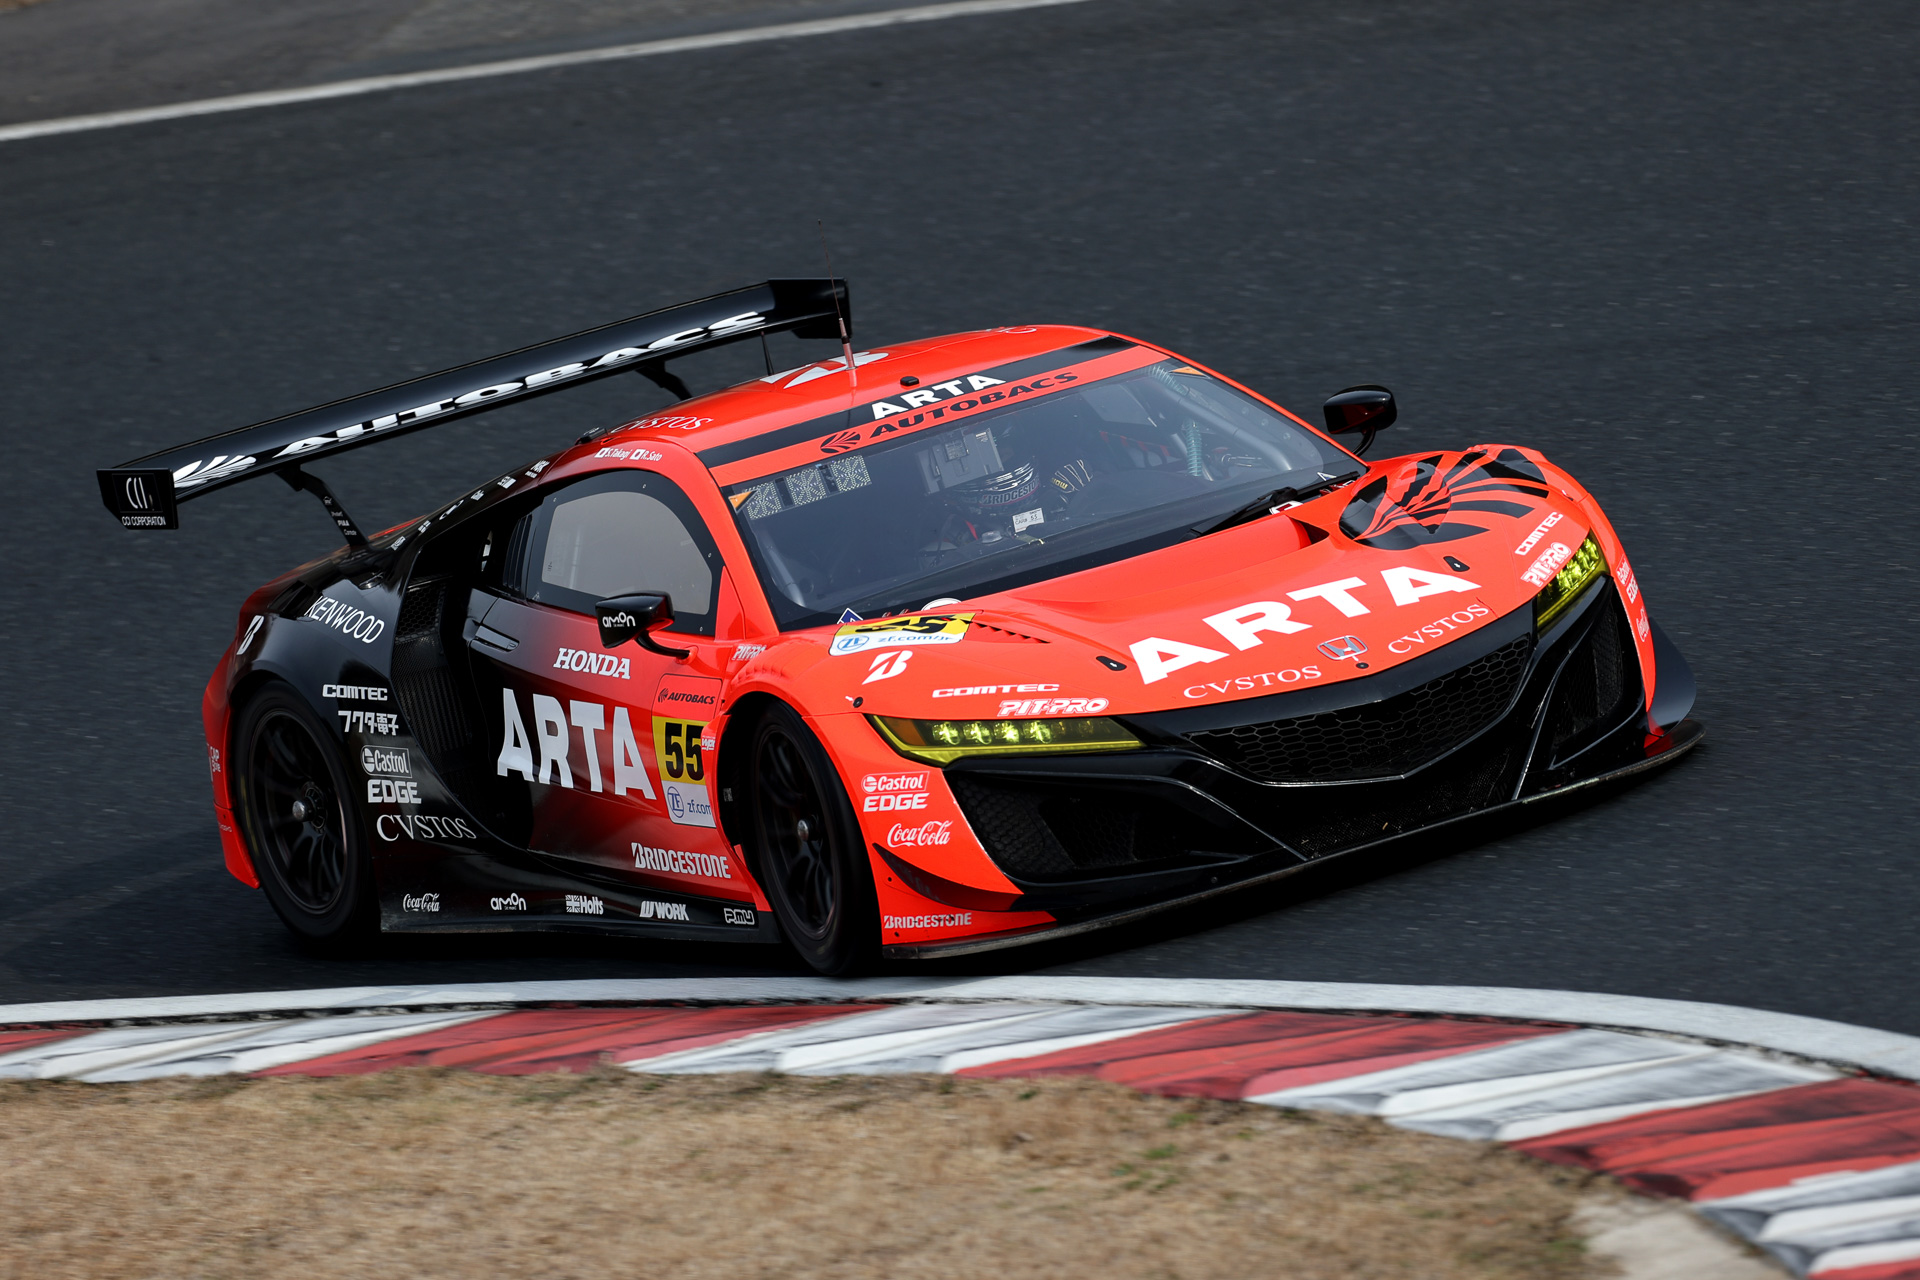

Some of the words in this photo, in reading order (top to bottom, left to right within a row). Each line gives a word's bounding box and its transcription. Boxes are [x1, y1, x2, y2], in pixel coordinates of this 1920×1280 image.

[273, 311, 766, 460] AUTOBACS
[871, 374, 1006, 420] ARTA
[869, 371, 1079, 438] AUTOBACS
[1515, 511, 1564, 556] COMTEC
[304, 596, 385, 644] KENWOOD
[602, 612, 636, 628] amon
[1129, 566, 1482, 685] ARTA
[1388, 604, 1489, 654] CVSTOS
[553, 647, 631, 680] HONDA
[322, 684, 387, 701] COMTEC
[932, 683, 1059, 698] COMTEC
[1183, 665, 1322, 699] CVSTOS
[667, 692, 716, 705] AUTOBACS
[497, 687, 657, 800] ARTA
[665, 722, 704, 781] 55
[374, 749, 409, 774] Castrol
[367, 779, 422, 804] EDGE
[877, 773, 924, 792] Castrol
[863, 793, 930, 812] EDGE
[376, 814, 477, 842] CVSTOS
[887, 820, 954, 848] Coca-Cola
[631, 842, 731, 879] BRIDGESTONE
[490, 892, 526, 911] amon
[579, 895, 604, 915] Holts
[655, 901, 689, 921] WORK
[883, 912, 972, 929] BRIDGESTONE
